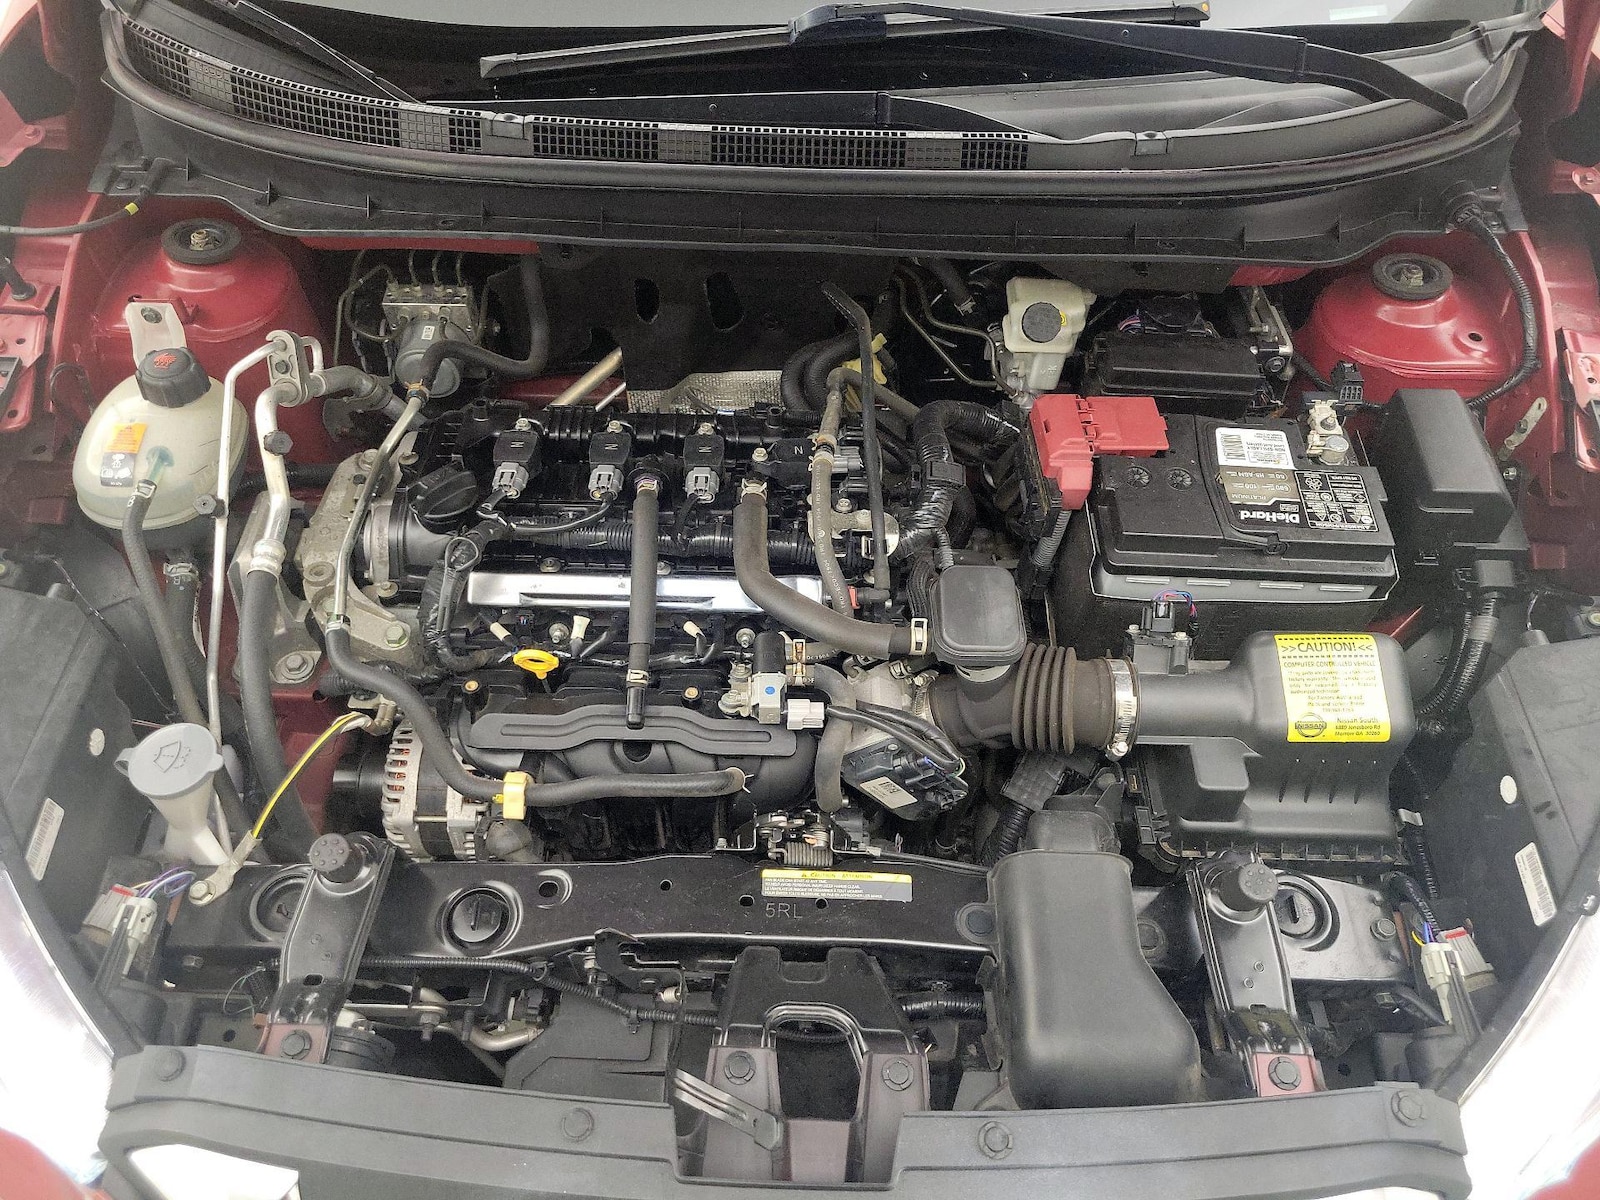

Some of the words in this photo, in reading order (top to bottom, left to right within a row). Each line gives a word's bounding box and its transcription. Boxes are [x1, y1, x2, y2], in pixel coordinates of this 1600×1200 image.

[794, 446, 803, 455] N
[1240, 511, 1300, 524] DieHard
[765, 902, 803, 919] 5RL
